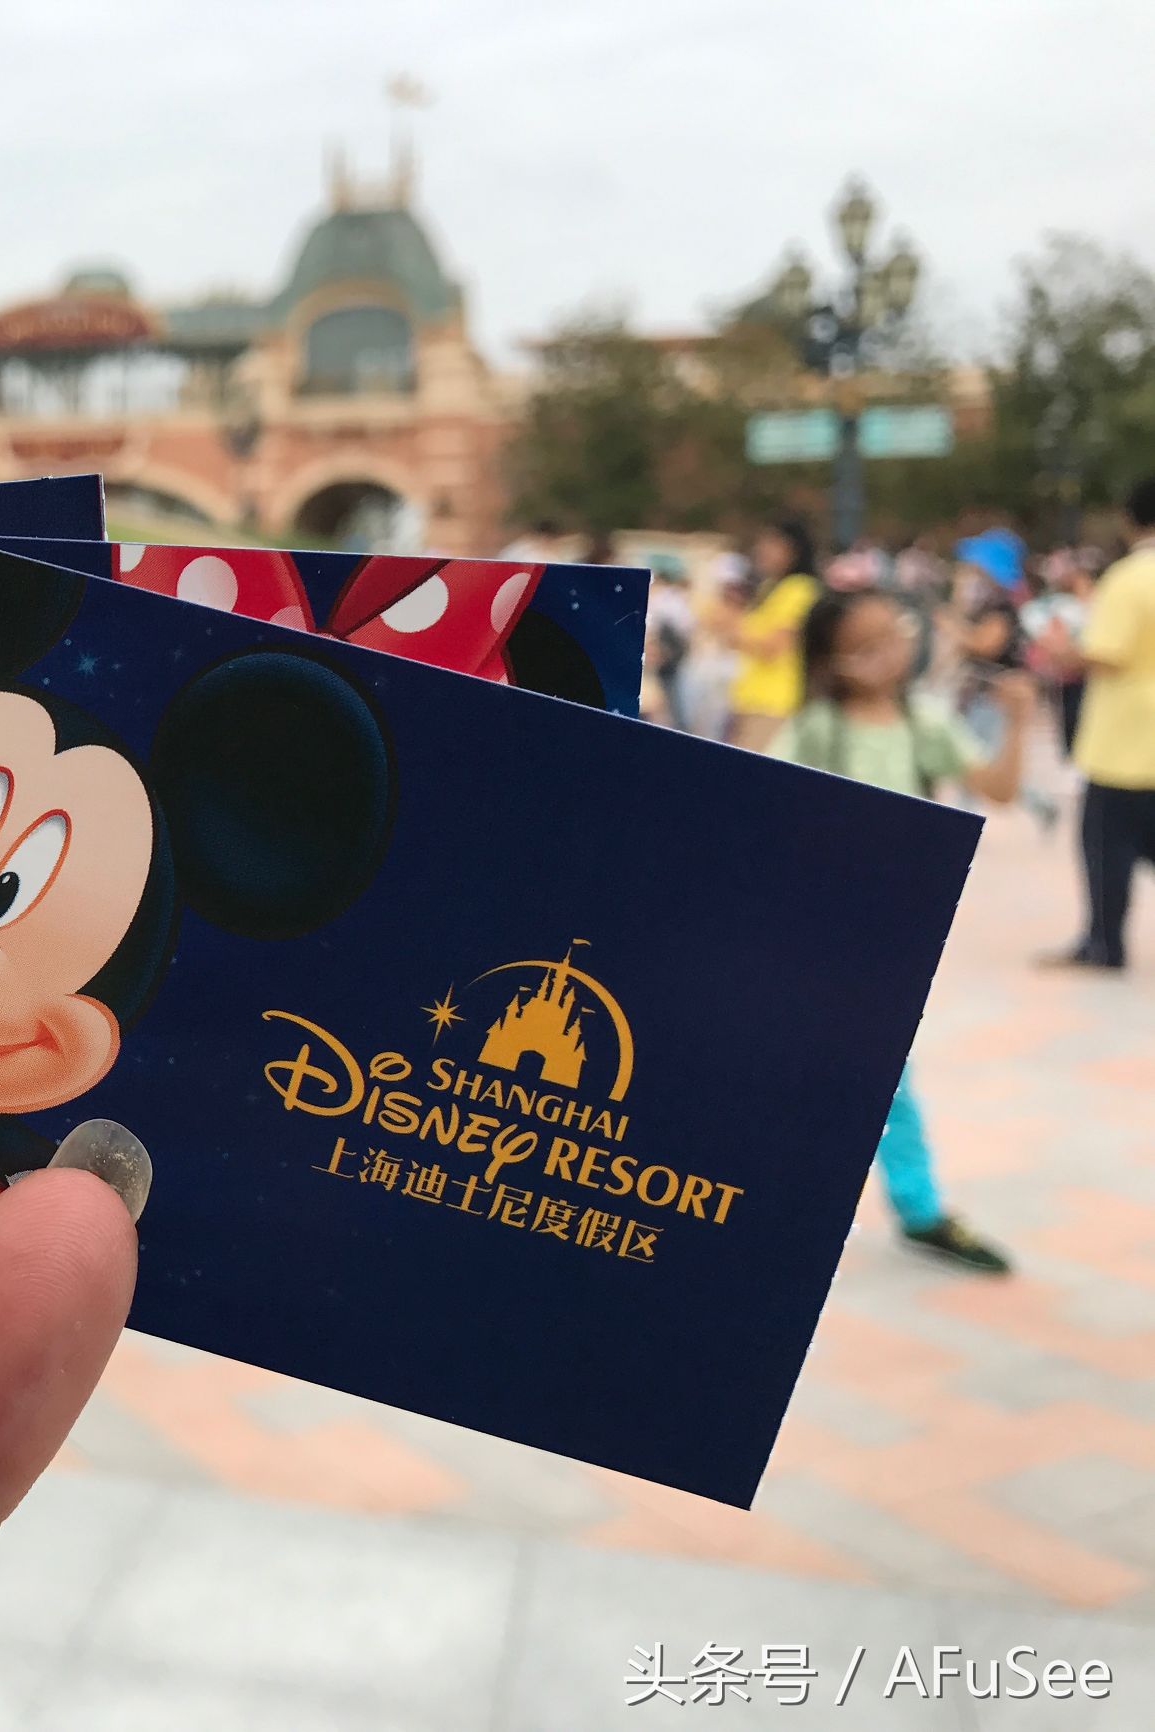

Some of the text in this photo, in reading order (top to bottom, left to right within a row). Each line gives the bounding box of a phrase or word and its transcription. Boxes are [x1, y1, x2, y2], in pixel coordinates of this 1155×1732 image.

[426, 1057, 630, 1142] SHANGHAI
[311, 1137, 665, 1263] 上海迪士尼度假区
[543, 1136, 745, 1225] RESORT
